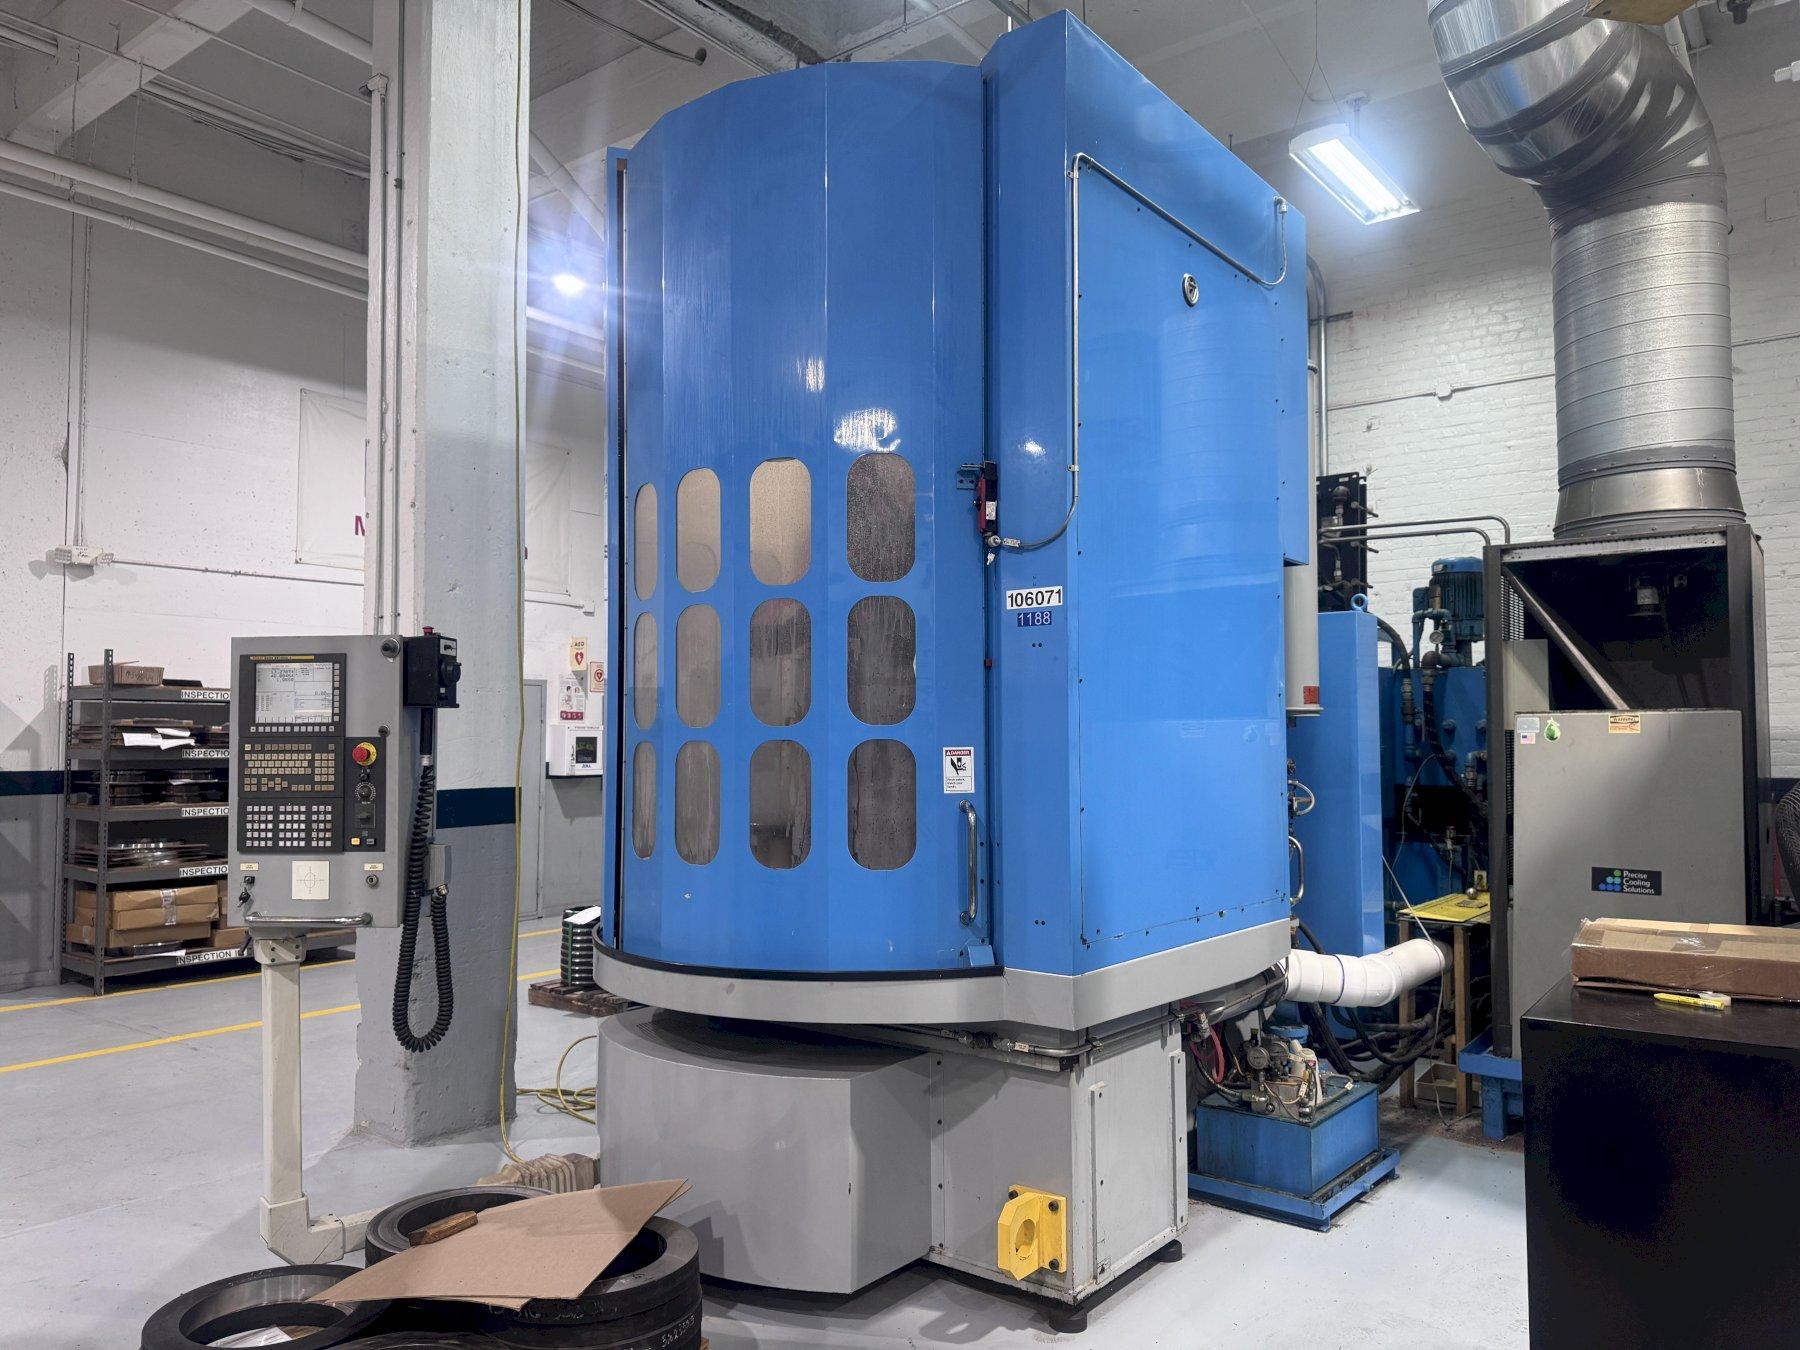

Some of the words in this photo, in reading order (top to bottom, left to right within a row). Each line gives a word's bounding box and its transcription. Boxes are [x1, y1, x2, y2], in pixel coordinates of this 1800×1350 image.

[1008, 588, 1061, 607] 106071
[1018, 611, 1051, 626] 1188
[181, 691, 229, 699] INSPECTIO
[182, 749, 230, 757] INSPECTIO
[182, 807, 229, 816] INSPECTIO
[180, 866, 228, 876] INSPECTIO
[1623, 870, 1648, 879] Precise
[1623, 877, 1651, 888] Cooling
[1623, 884, 1655, 895] Solutions
[176, 951, 231, 965] INSPECTION
